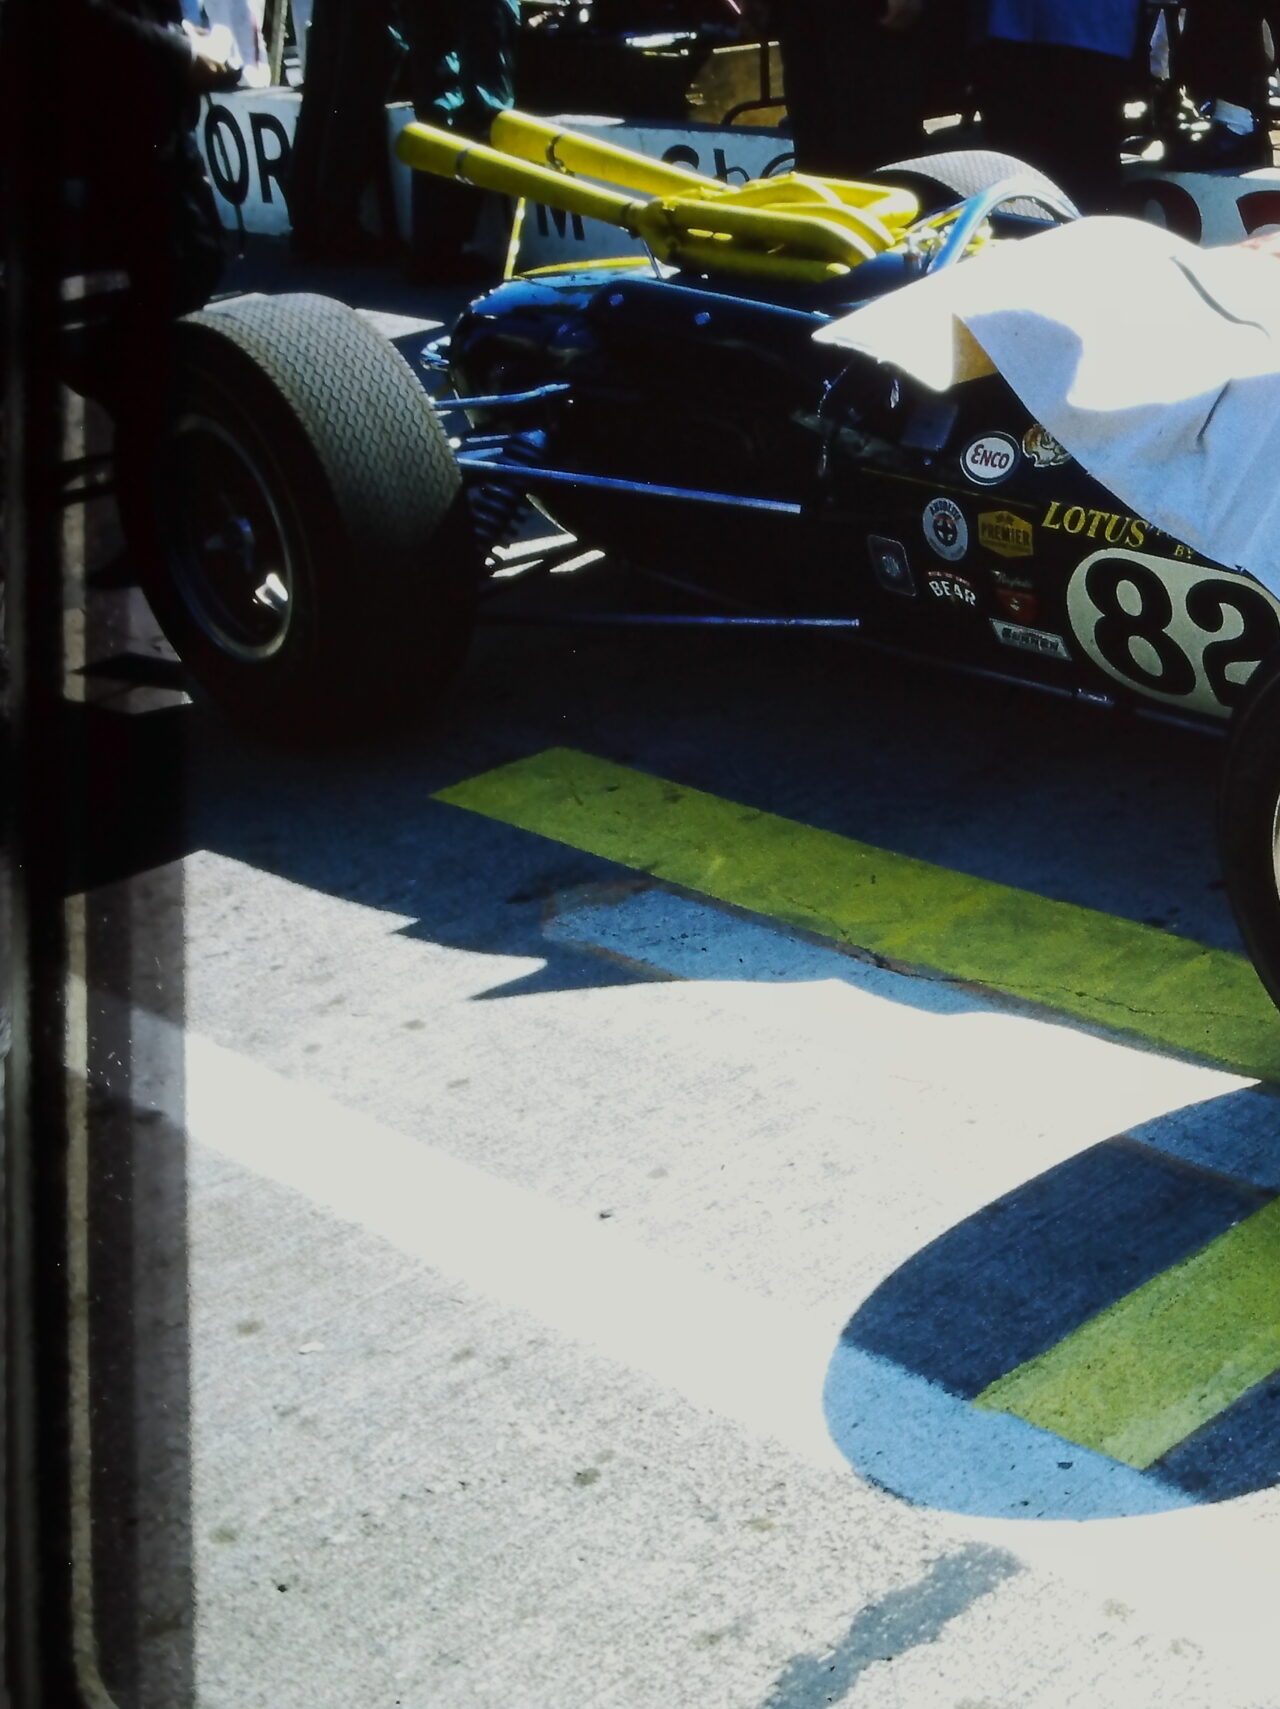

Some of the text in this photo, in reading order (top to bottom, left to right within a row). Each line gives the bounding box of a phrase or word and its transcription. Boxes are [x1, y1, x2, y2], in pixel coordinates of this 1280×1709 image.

[970, 443, 1010, 469] ENCO
[1041, 501, 1150, 548] LOTUS
[928, 580, 976, 605] BEAR
